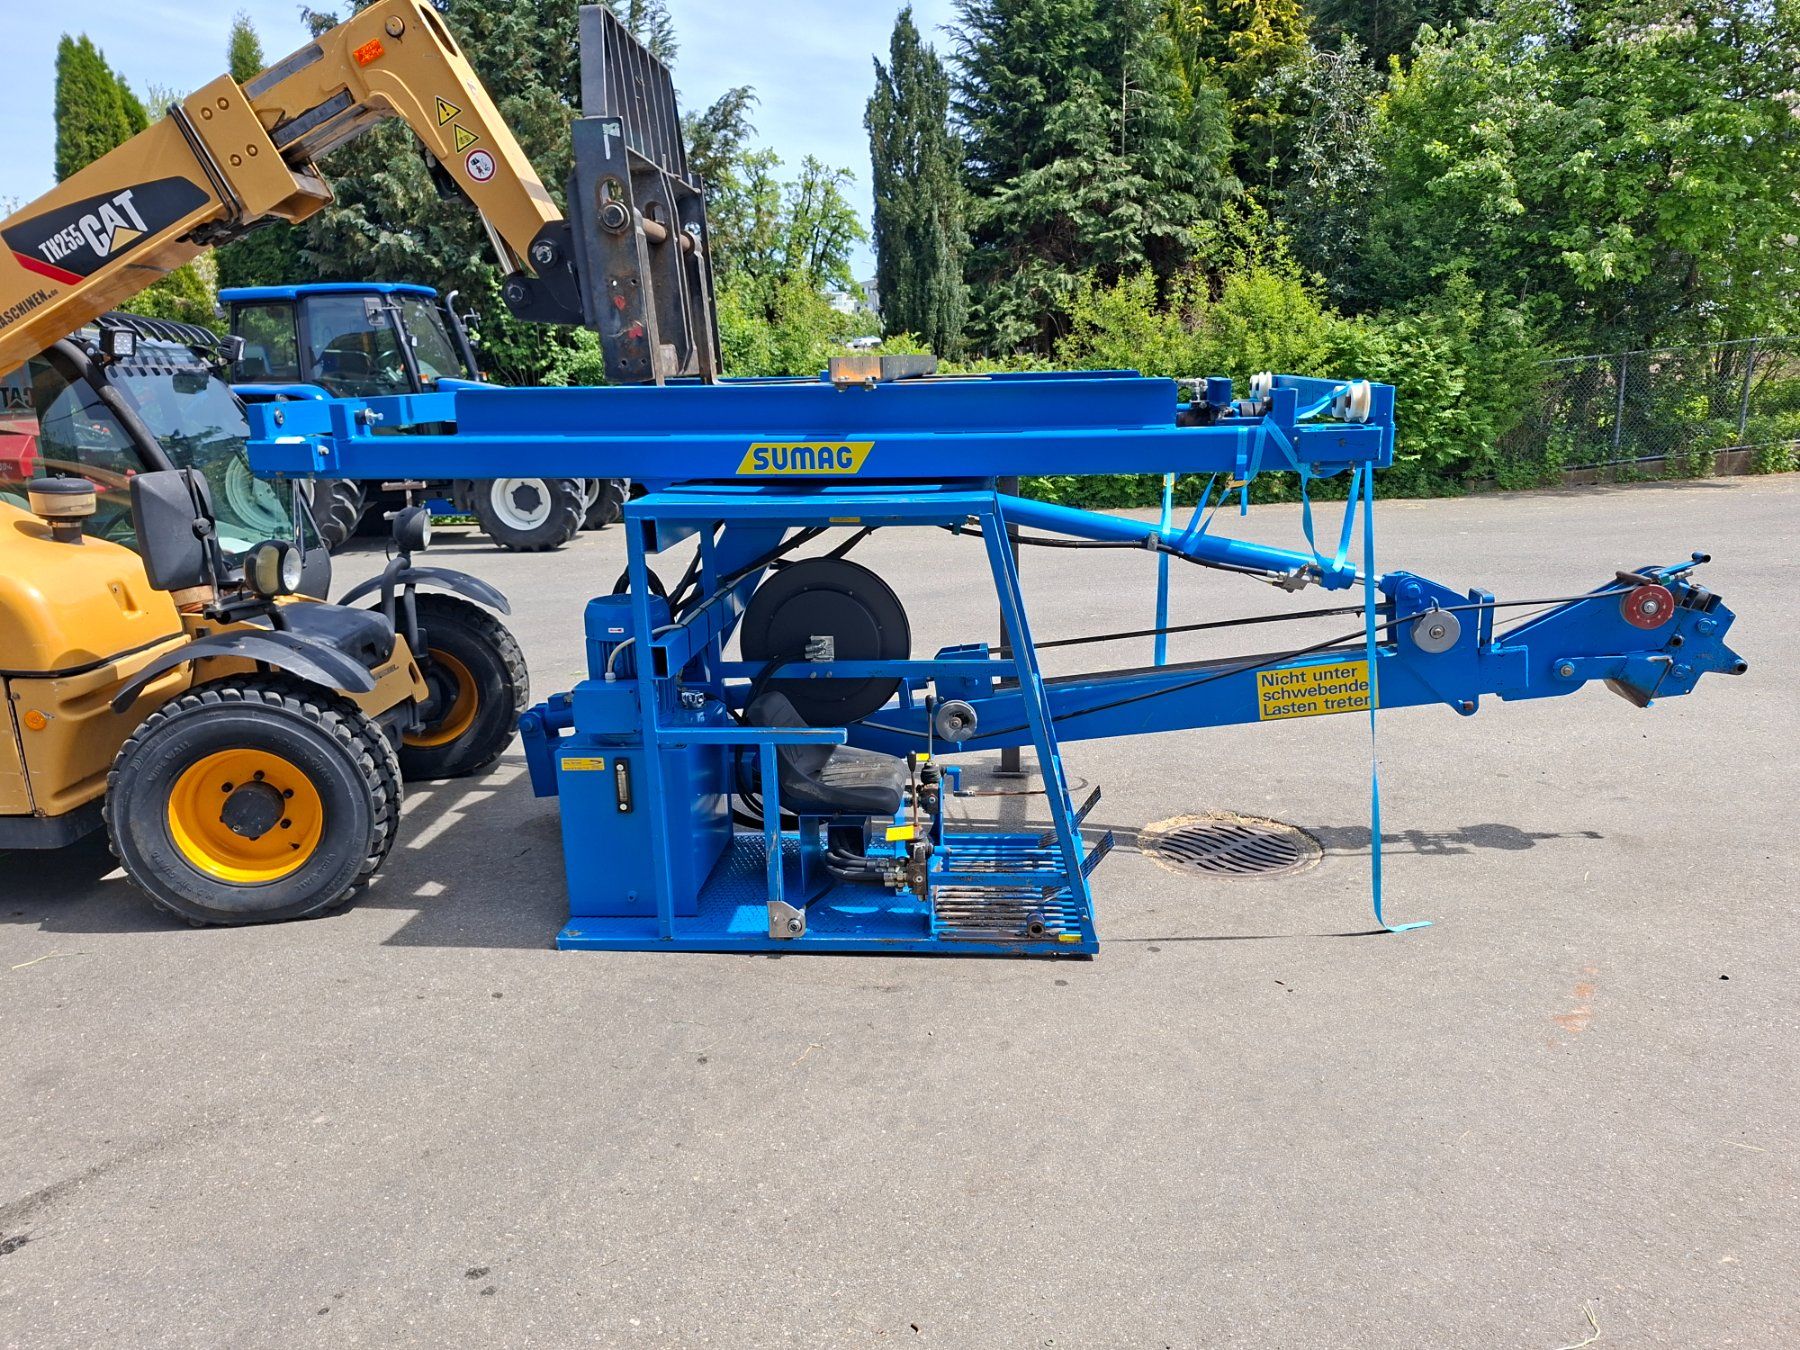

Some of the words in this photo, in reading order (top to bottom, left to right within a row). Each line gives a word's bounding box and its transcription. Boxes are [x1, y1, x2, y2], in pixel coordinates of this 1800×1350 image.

[38, 223, 86, 264] TH255
[79, 189, 149, 258] CAT
[753, 446, 853, 470] SUMAG
[1261, 671, 1306, 687] Nicht
[1313, 667, 1357, 681] unter
[1263, 679, 1369, 701] schwebende
[1264, 701, 1317, 716] Lasten
